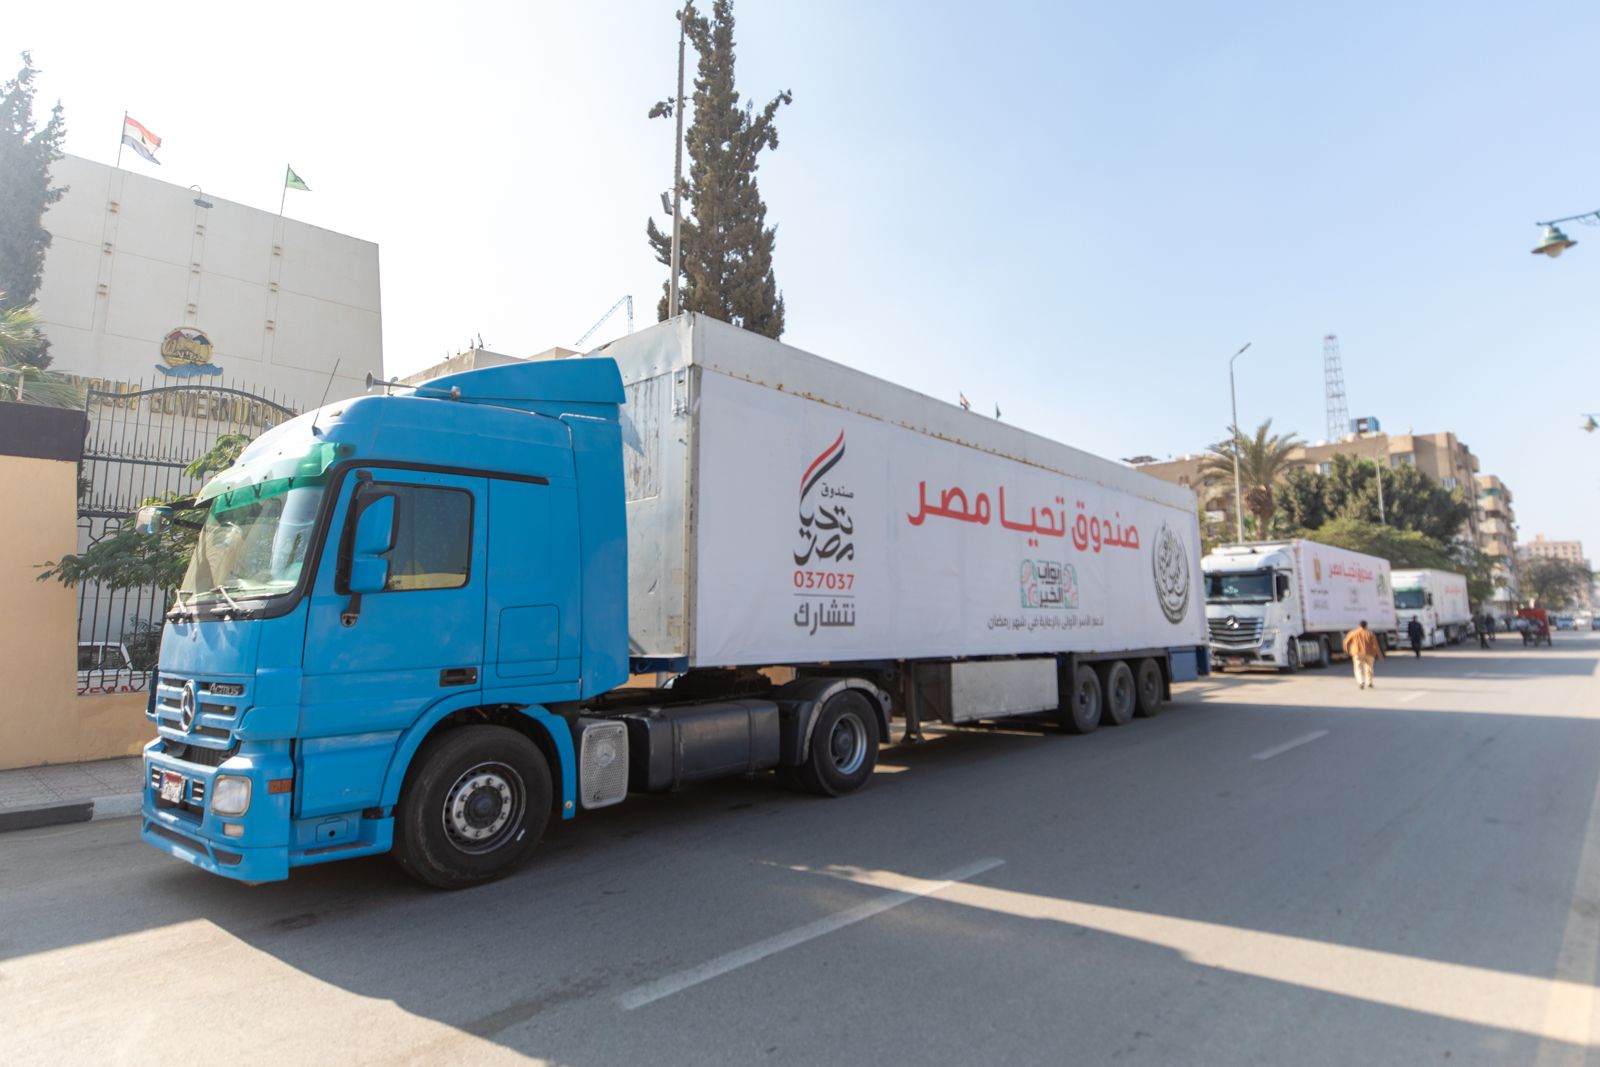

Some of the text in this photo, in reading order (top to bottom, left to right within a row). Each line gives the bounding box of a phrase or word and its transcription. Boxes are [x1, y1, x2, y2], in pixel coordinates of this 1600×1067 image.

[820, 483, 854, 499] صندوق
[906, 480, 1139, 553] صندوق تحيا مصر
[793, 570, 855, 591] 037037
[794, 600, 855, 636] نتشارك
